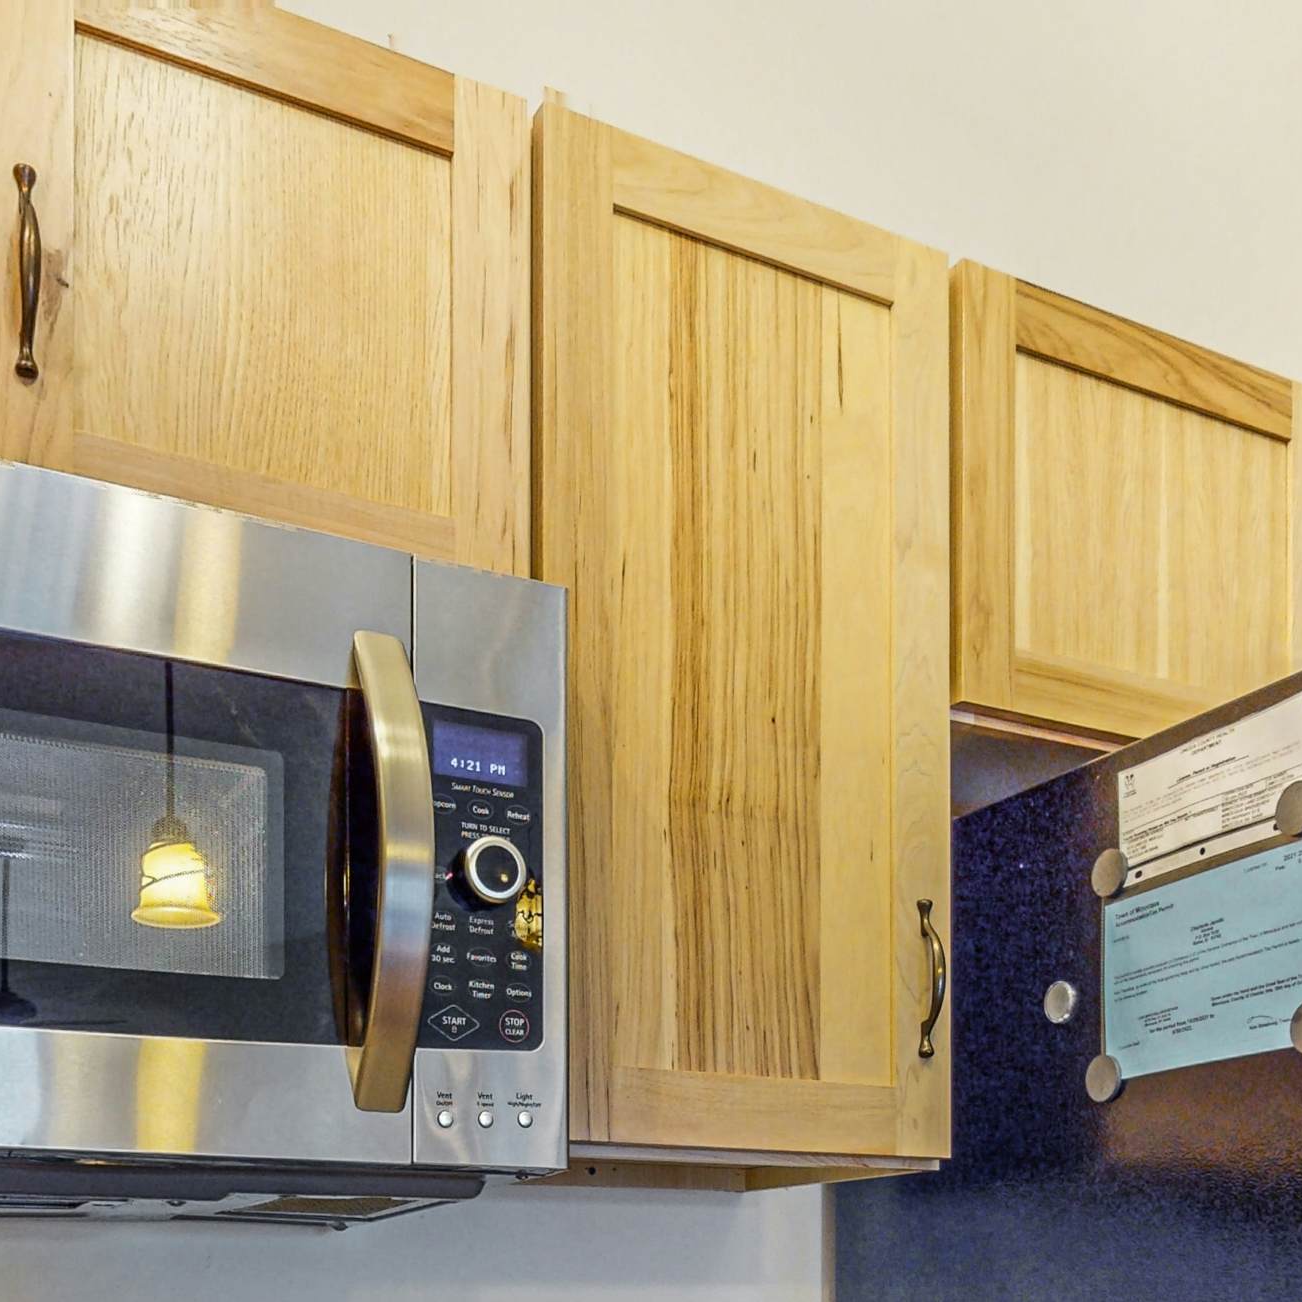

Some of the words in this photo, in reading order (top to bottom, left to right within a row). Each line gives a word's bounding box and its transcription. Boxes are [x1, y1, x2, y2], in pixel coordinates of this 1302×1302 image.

[451, 758, 481, 772] 4:21
[490, 763, 506, 776] PM
[472, 806, 490, 815] Cook
[507, 810, 530, 821] Reheat
[461, 822, 477, 831] TURN
[480, 824, 488, 832] TO
[489, 825, 511, 835] SELECT
[434, 912, 451, 921] Auto
[469, 916, 494, 926] Express
[469, 926, 494, 935] Defrost
[437, 945, 450, 953] Add
[466, 952, 497, 963] Favorites
[511, 952, 527, 960] Cook
[511, 962, 527, 970] Time
[434, 982, 452, 991] Clock
[469, 980, 494, 990] Kitchen
[472, 991, 491, 999] Timer
[506, 988, 532, 998] Options
[442, 1016, 466, 1025] START
[505, 1018, 525, 1026] STOP
[505, 1028, 524, 1036] CLEAR
[437, 1091, 452, 1099] Vent
[478, 1092, 493, 1100] Vent
[516, 1092, 533, 1101] Light
